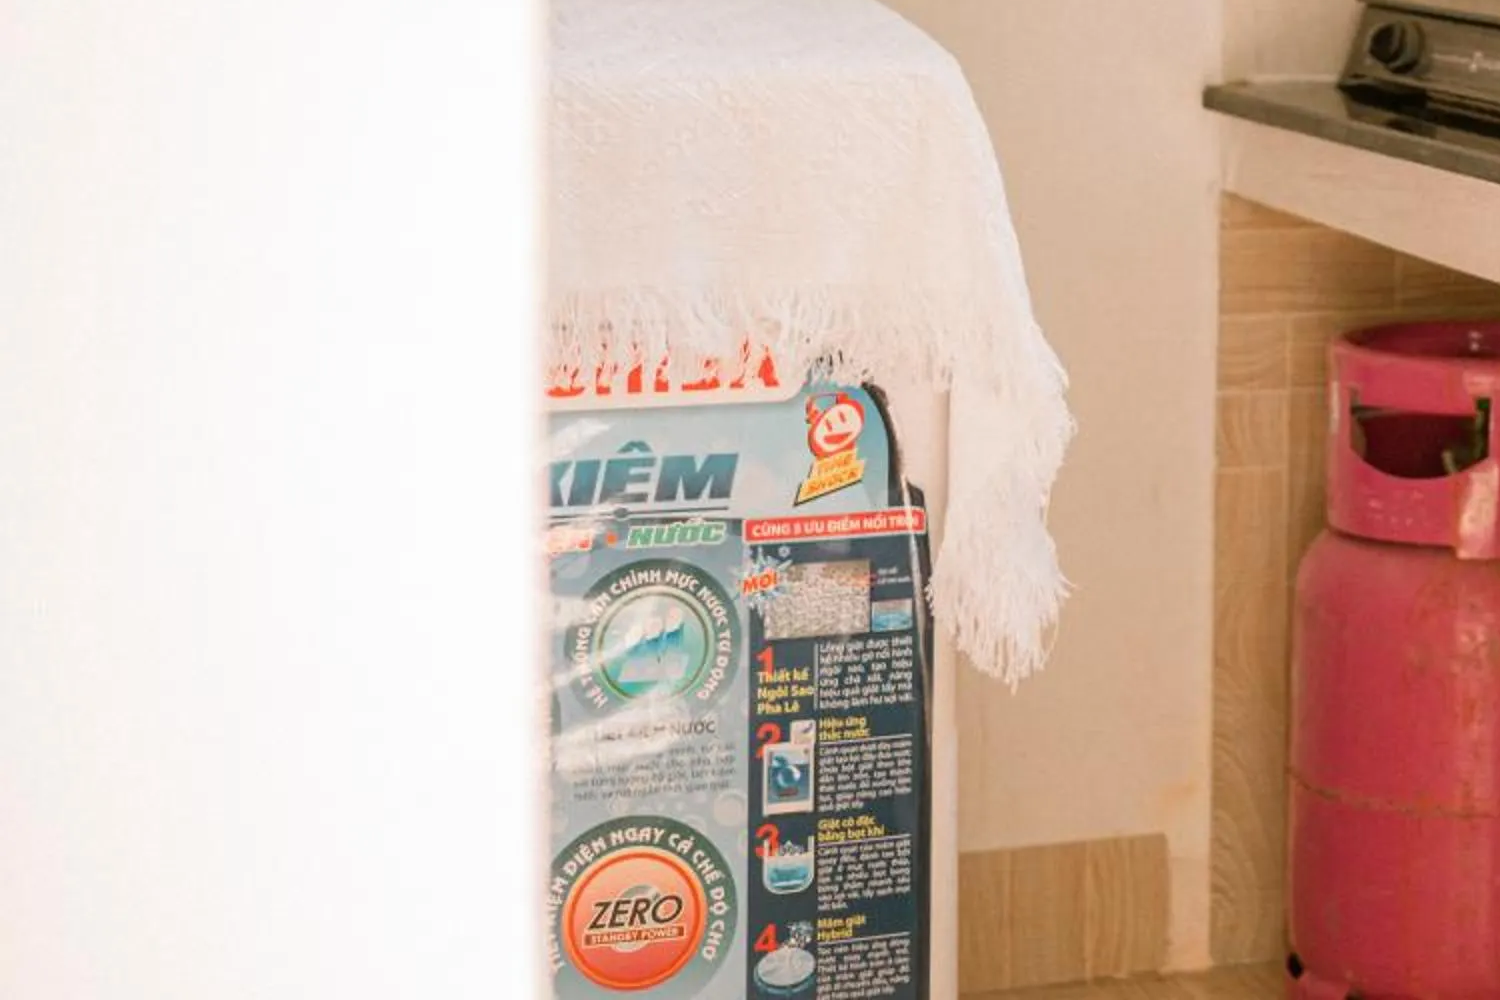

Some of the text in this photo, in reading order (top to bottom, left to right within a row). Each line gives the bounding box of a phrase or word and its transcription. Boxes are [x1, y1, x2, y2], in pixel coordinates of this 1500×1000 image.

[755, 643, 775, 677] 1
[756, 722, 782, 759] 2
[755, 823, 780, 857] 3
[588, 894, 685, 931] ZERO
[641, 927, 680, 940] POWER
[754, 922, 778, 952] 4
